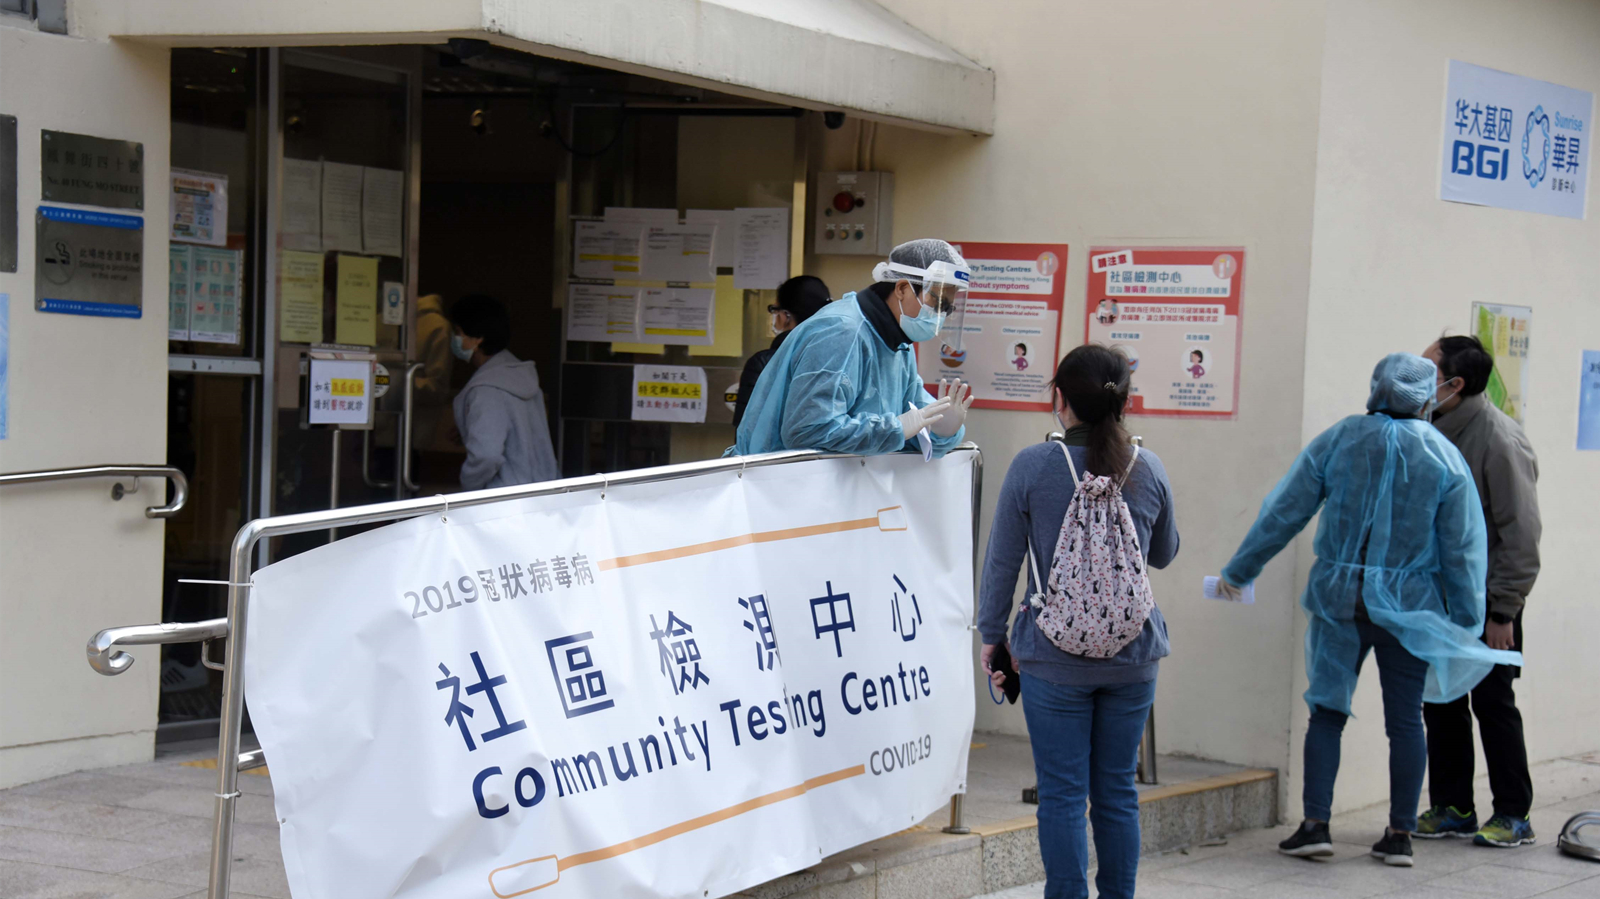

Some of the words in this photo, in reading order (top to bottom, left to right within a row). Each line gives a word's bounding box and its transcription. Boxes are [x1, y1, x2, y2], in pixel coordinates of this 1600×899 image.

[1455, 98, 1513, 143] 华大基因
[1554, 111, 1583, 132] Sunrise
[1451, 140, 1509, 181] BGI
[1552, 133, 1580, 174] 華昇
[968, 281, 991, 289] ithout
[992, 282, 1030, 291] symptoms
[980, 264, 1004, 273] Testing
[1005, 265, 1032, 273] Centres
[1110, 271, 1182, 283] 社區檢測中心
[652, 372, 687, 381] 如閣下是
[404, 552, 595, 619] 2019冠狀病毒病
[435, 573, 923, 752] 社區檢測中心
[471, 715, 711, 819] Community
[719, 682, 827, 747] Tesing
[840, 661, 931, 716] Centre
[870, 734, 931, 776] COVID-19
